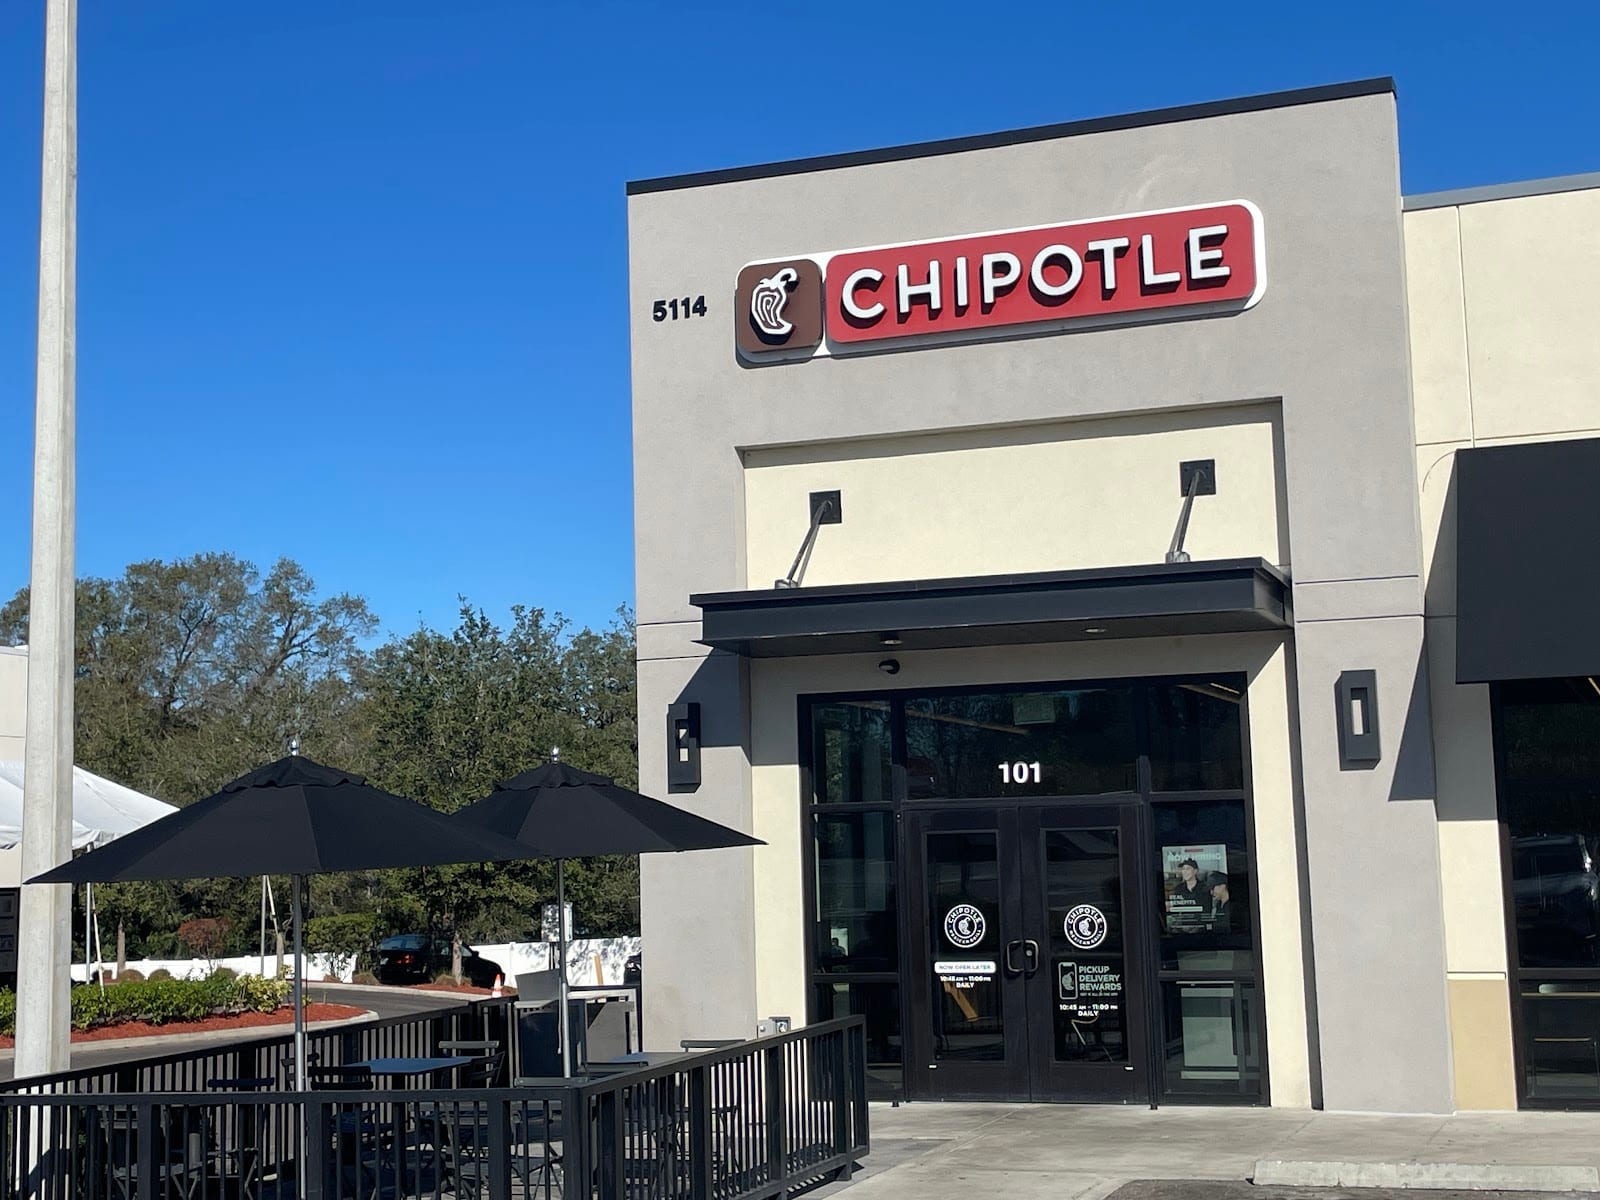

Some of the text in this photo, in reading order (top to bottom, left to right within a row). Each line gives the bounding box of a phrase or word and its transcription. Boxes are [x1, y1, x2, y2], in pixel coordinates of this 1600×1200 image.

[841, 224, 1232, 321] CHIPOTLE
[652, 295, 708, 322] 5114
[998, 761, 1041, 784] 101
[948, 908, 982, 923] CHIPOTLE
[1068, 908, 1102, 924] CHIPOTLE
[1078, 965, 1110, 974] PICKUP
[1079, 974, 1120, 982] DELIVERY
[1079, 982, 1122, 991] REWARDS
